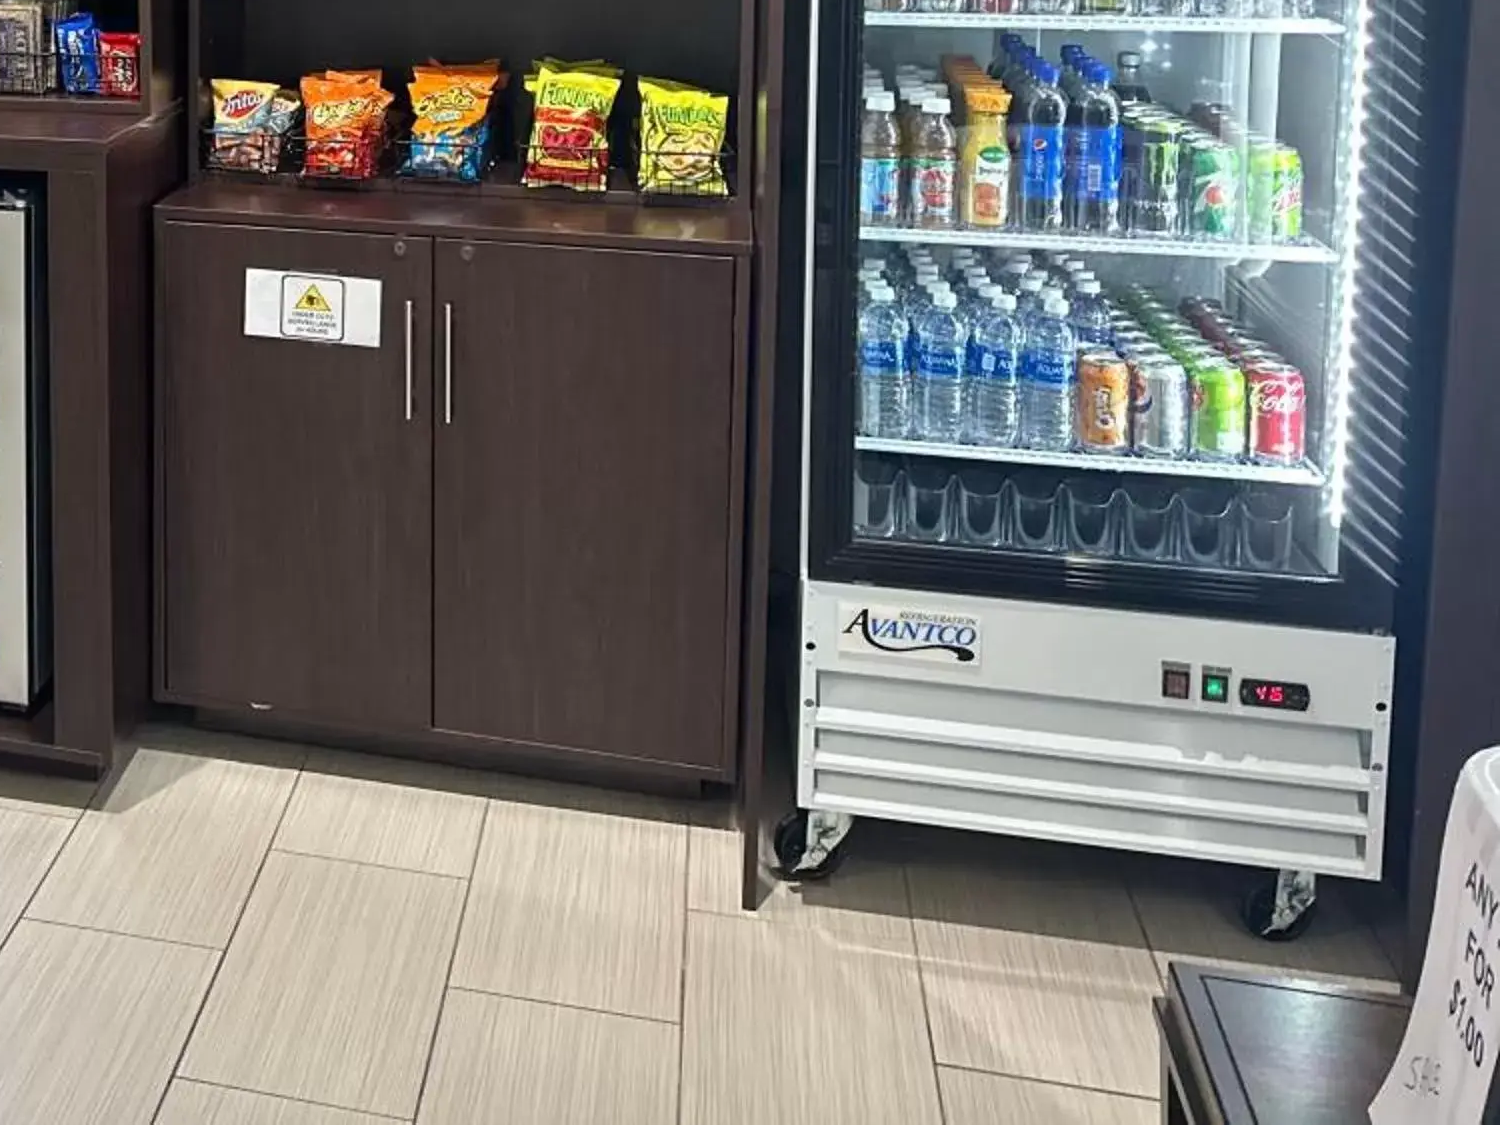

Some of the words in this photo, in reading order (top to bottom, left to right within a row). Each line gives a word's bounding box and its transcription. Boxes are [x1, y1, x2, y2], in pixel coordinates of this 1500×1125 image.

[842, 608, 977, 647] AVANTCO
[1465, 862, 1499, 929] ANY
[1465, 928, 1495, 1009] FOR
